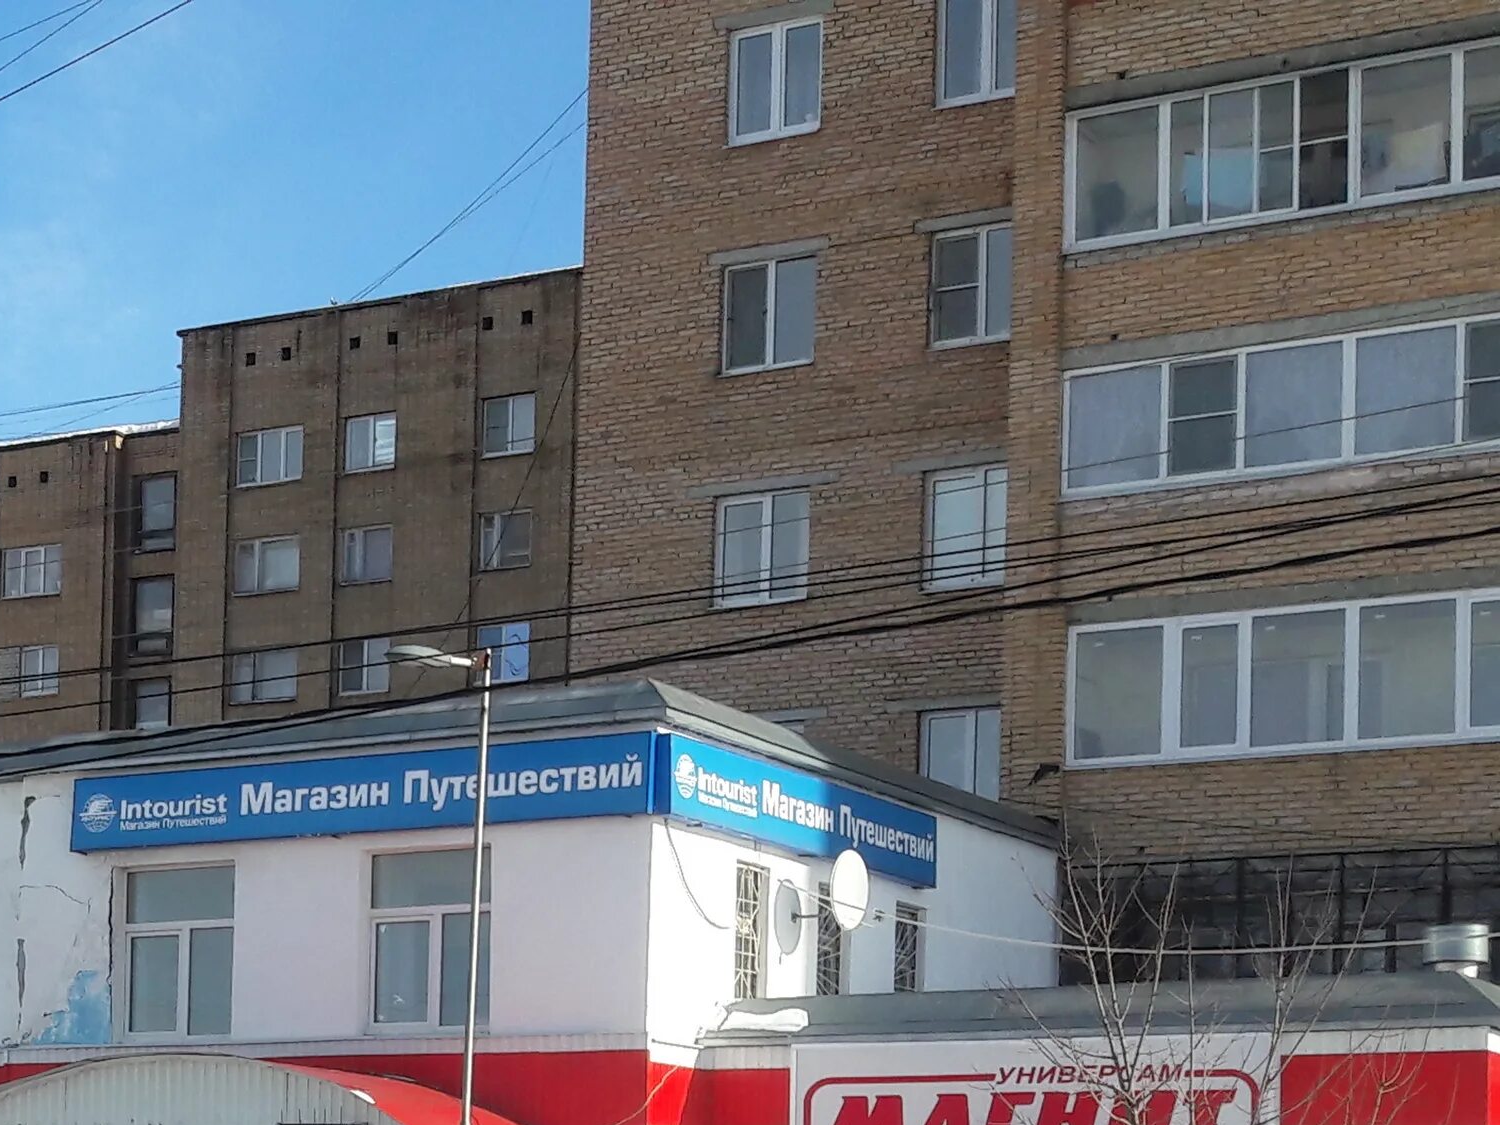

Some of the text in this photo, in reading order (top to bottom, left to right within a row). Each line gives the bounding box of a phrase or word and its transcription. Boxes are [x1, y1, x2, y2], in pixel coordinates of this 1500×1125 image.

[120, 794, 228, 820] Intourist
[239, 781, 390, 816] Магазин
[403, 753, 643, 812] Путешествий
[697, 766, 758, 807] Intourist
[761, 779, 835, 833] Магазин
[838, 804, 935, 863] Путешествий
